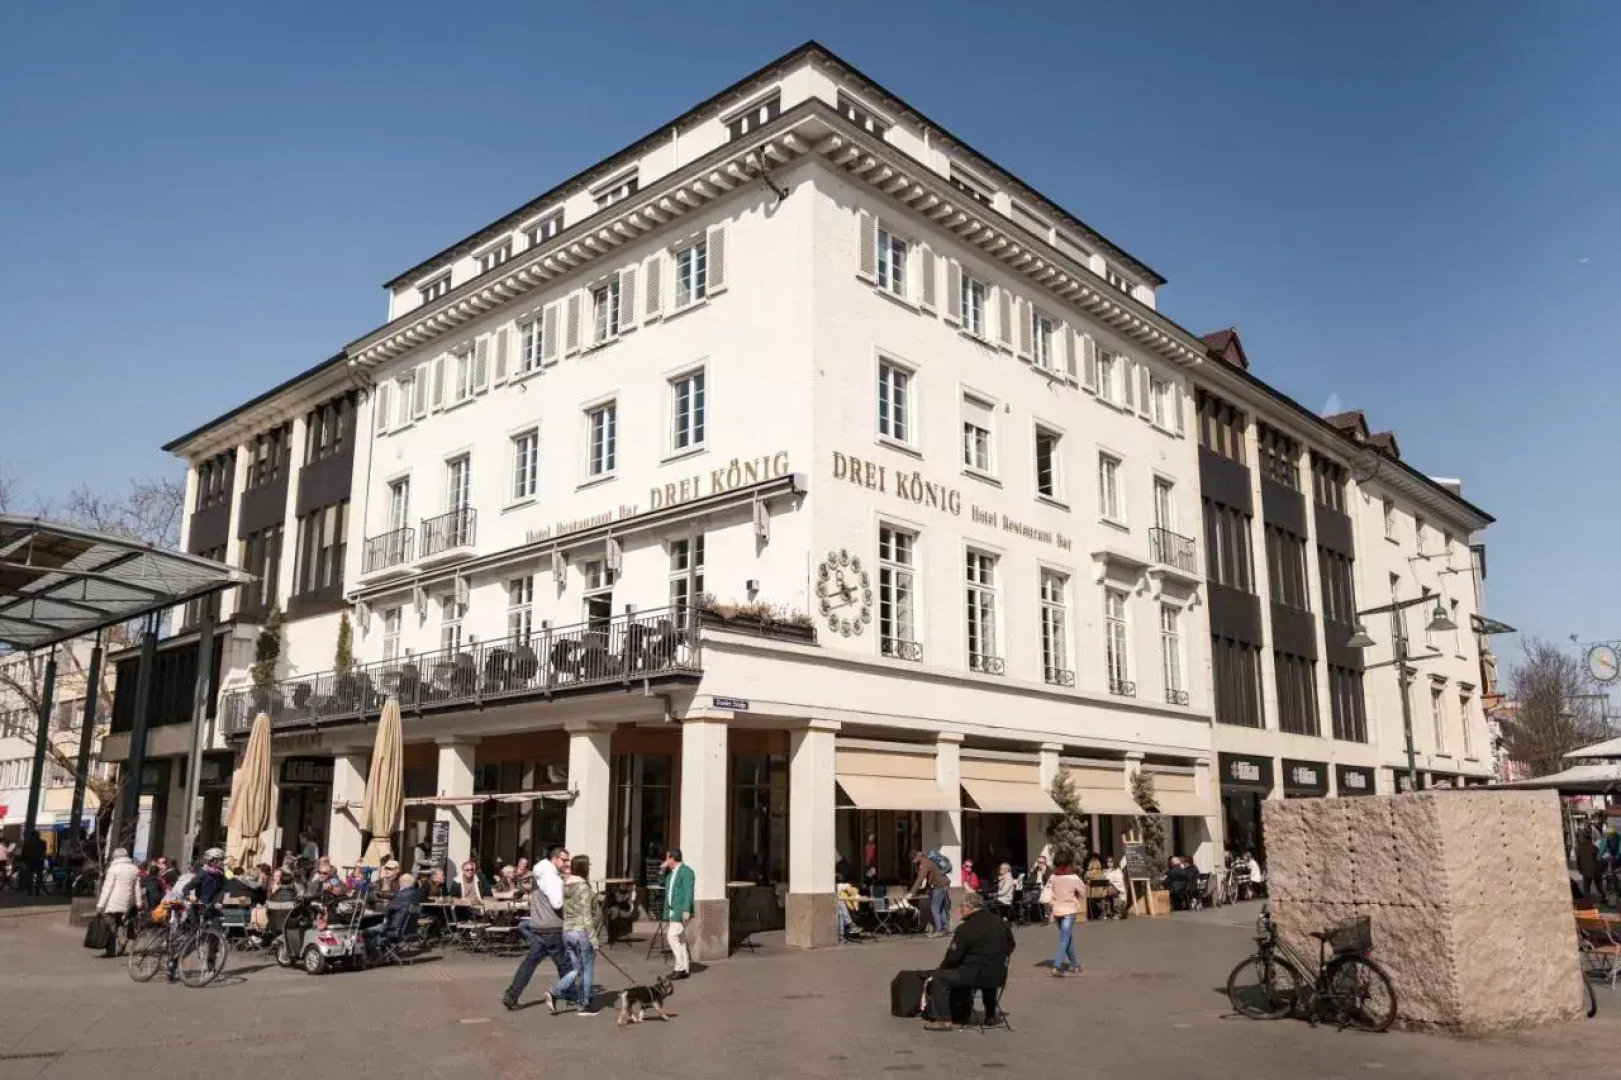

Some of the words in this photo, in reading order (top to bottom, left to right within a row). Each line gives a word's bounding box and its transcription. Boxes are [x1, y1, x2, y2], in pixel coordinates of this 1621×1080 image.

[650, 476, 700, 511] DREI
[711, 450, 790, 494] KÖNIG
[832, 451, 886, 492] DREI
[896, 471, 961, 516] KÖNIG
[972, 504, 997, 528] Hotel
[1003, 514, 1052, 545] Restaurant
